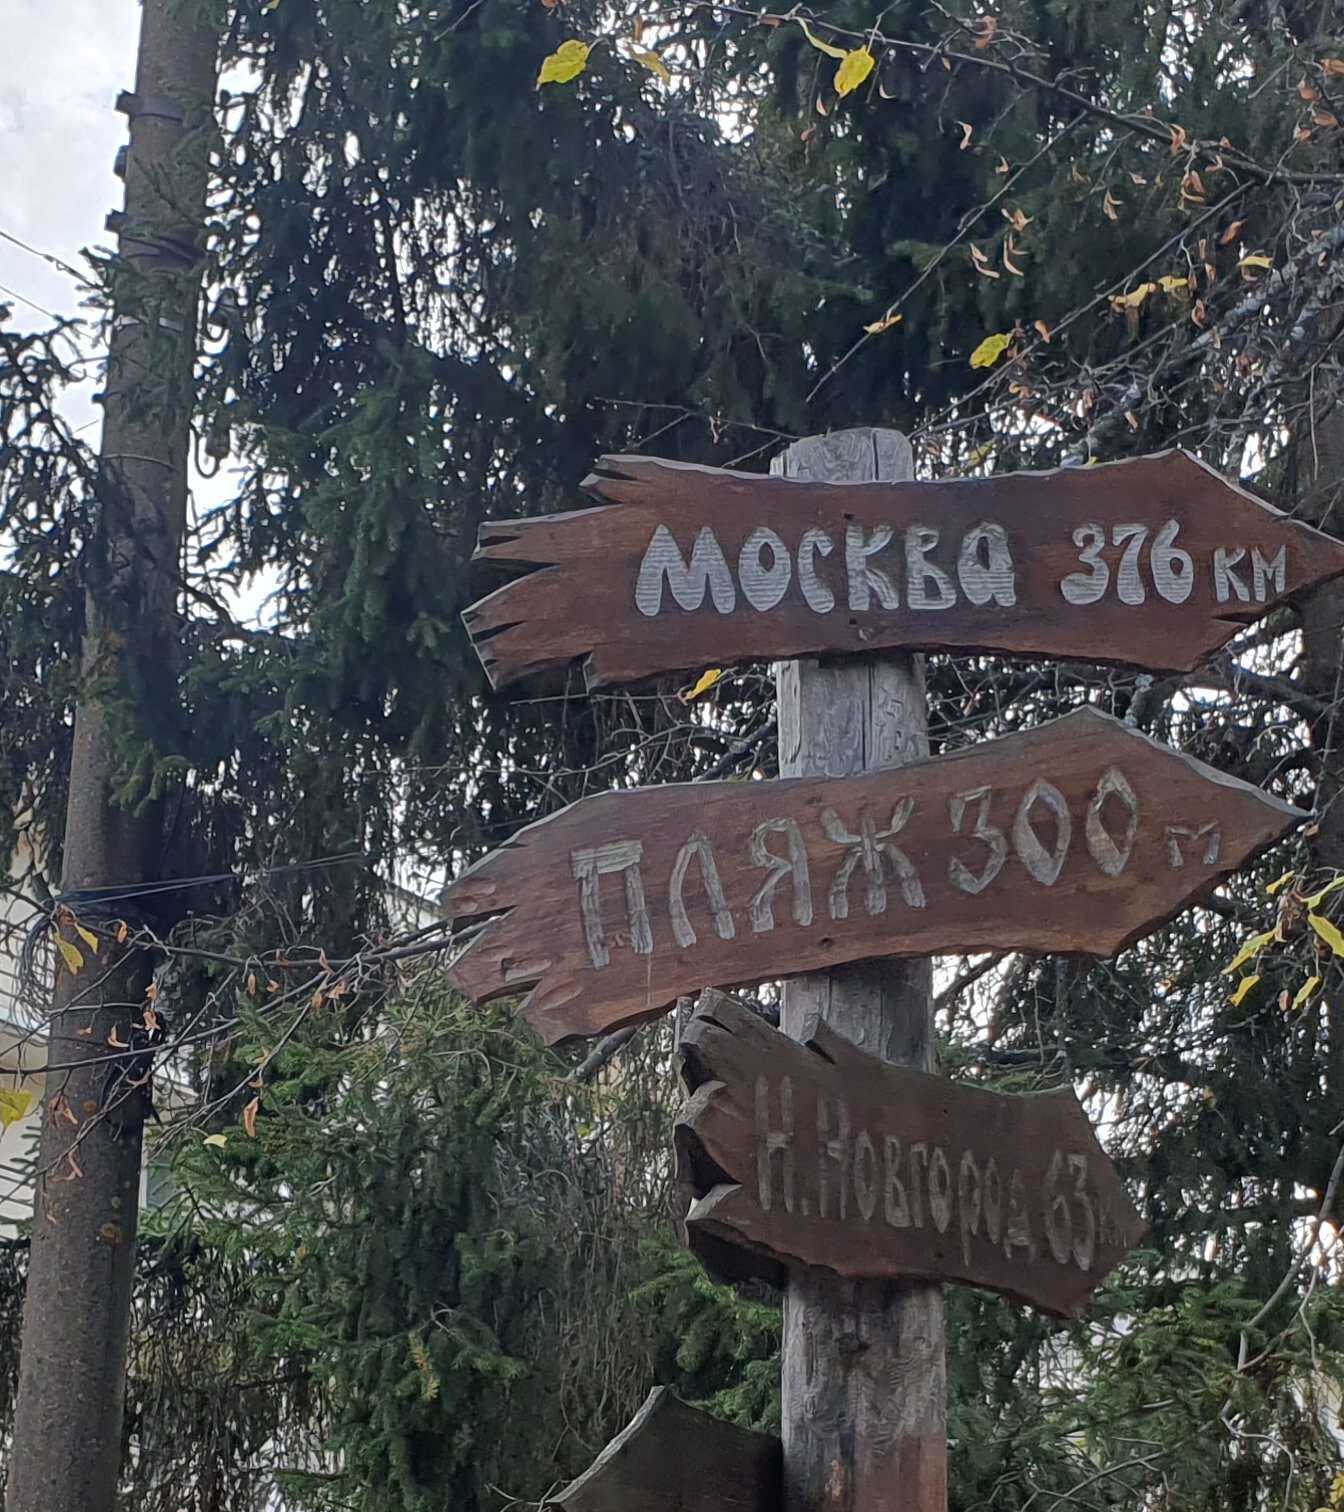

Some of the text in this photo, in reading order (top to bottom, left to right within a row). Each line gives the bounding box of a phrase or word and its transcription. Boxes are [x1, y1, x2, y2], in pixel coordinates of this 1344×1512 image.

[1059, 519, 1194, 606] 376
[570, 796, 926, 970] ПЛЯЖ
[948, 764, 1140, 895] 300
